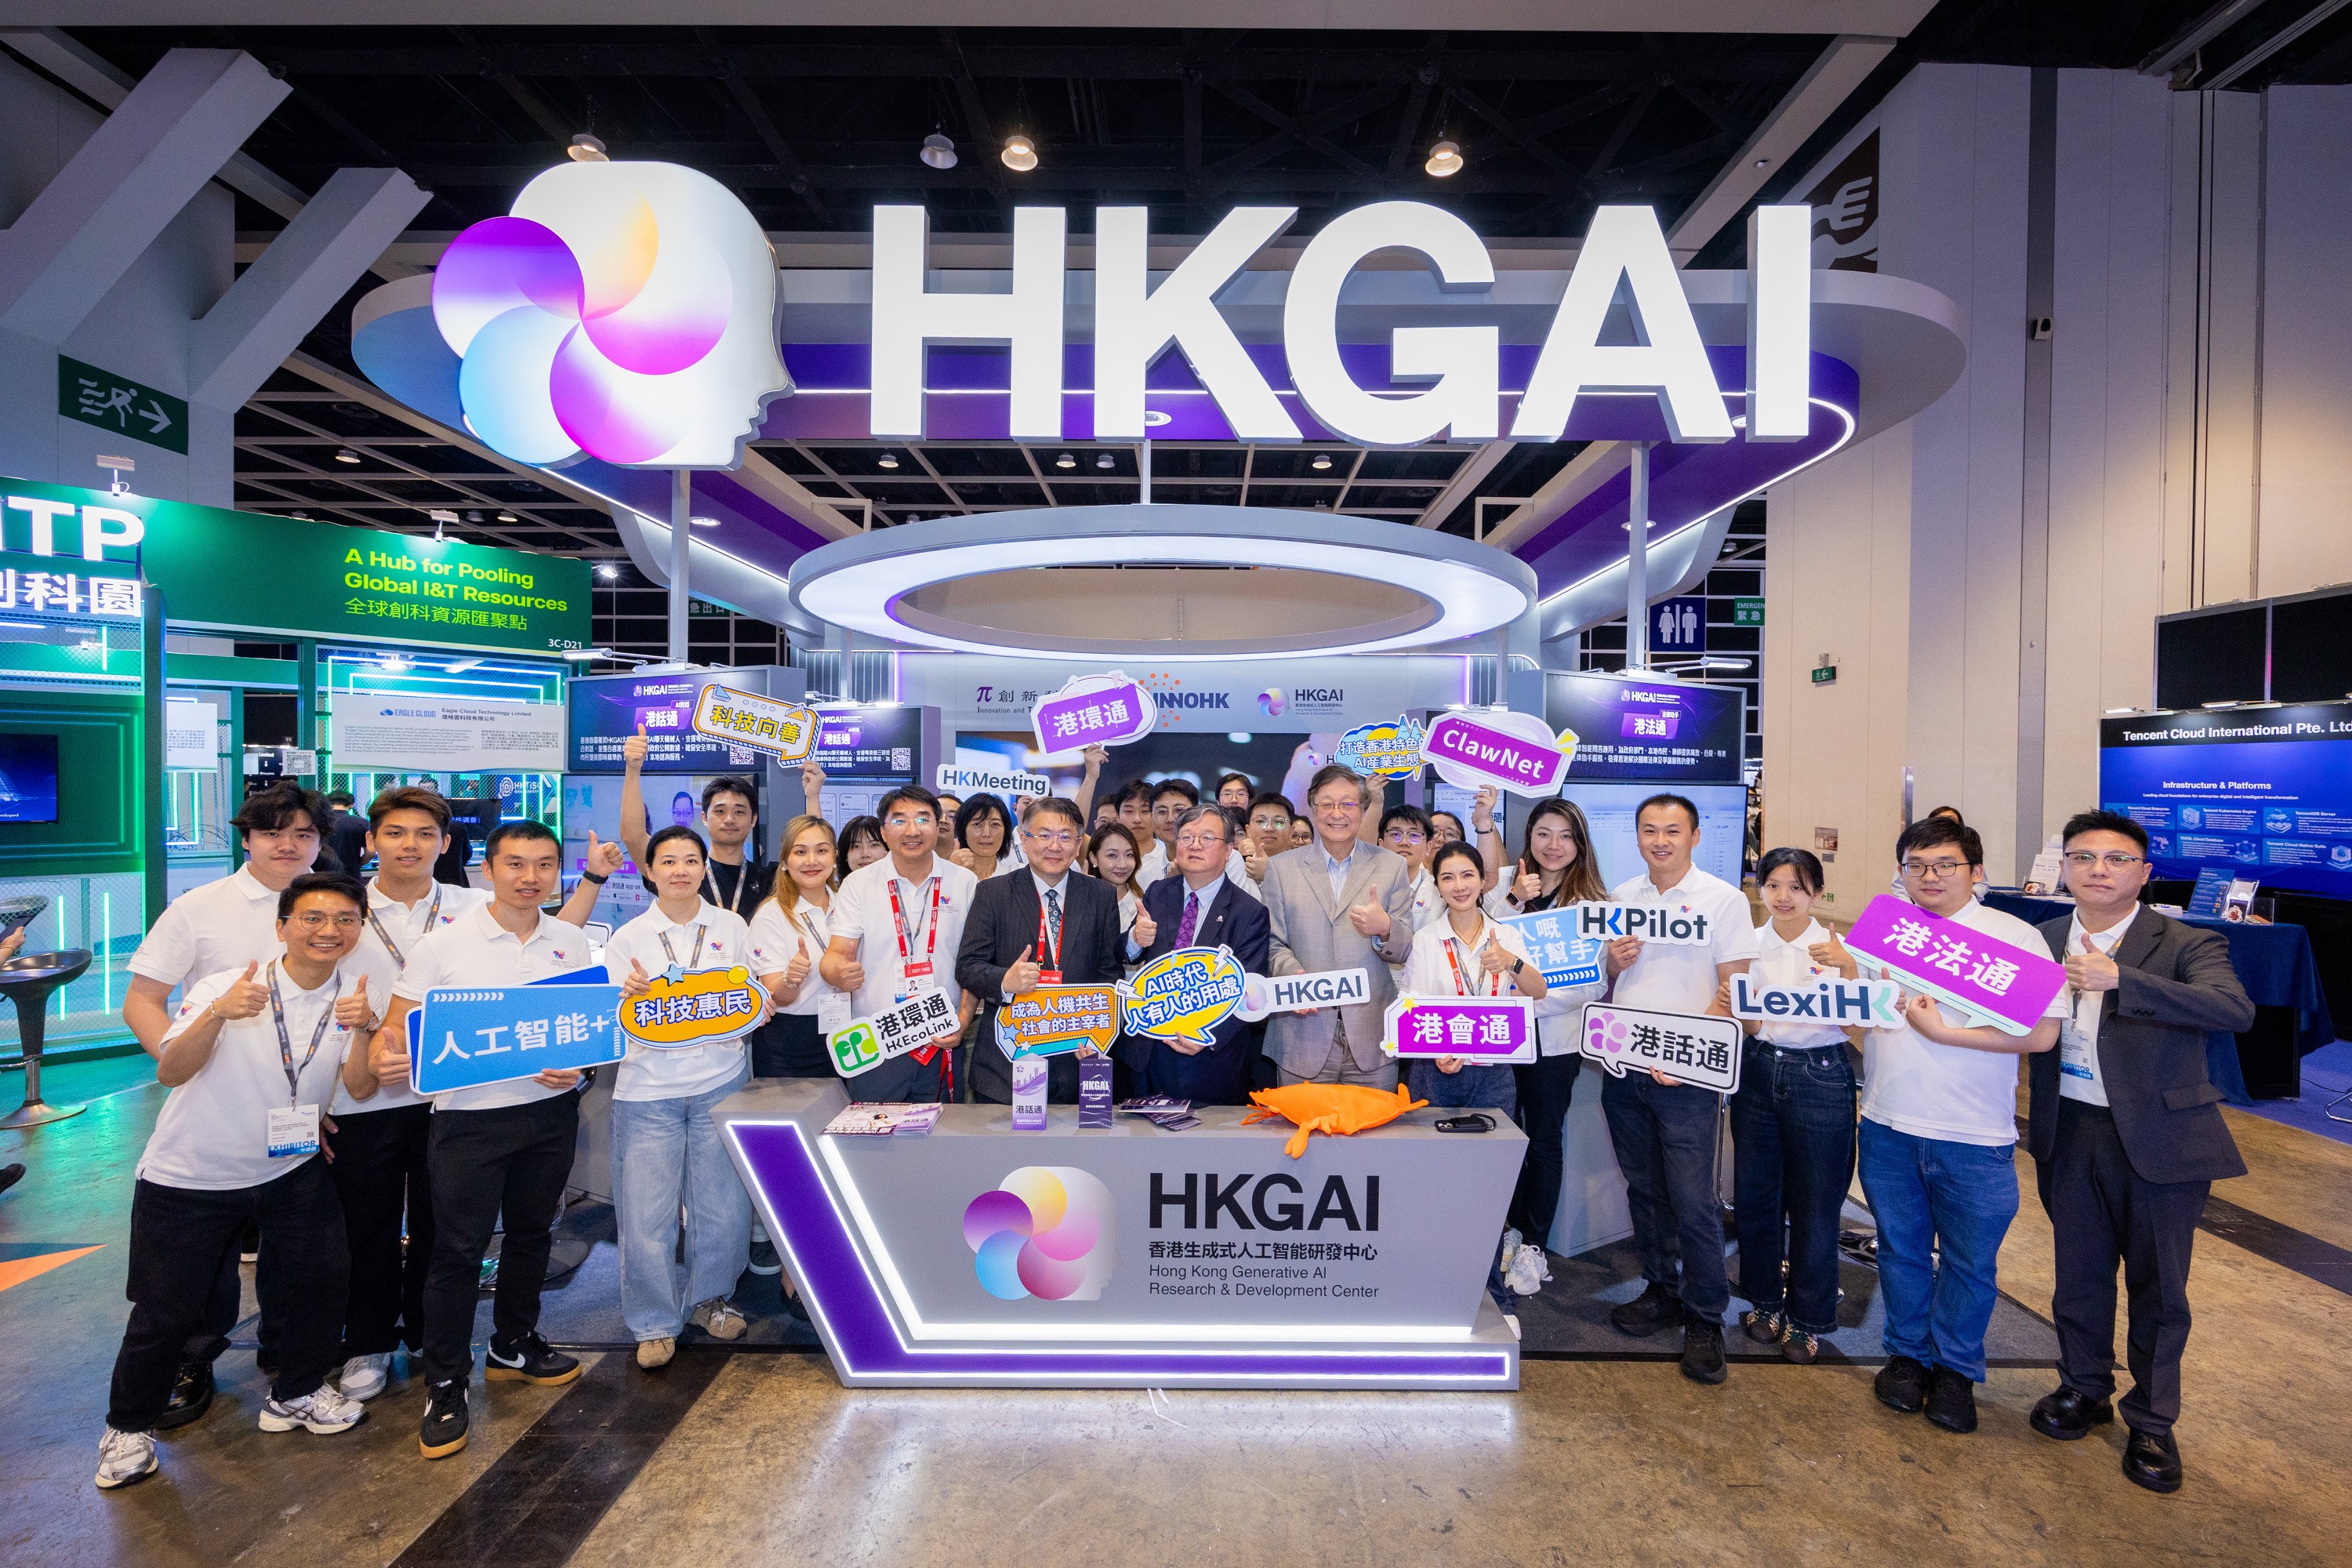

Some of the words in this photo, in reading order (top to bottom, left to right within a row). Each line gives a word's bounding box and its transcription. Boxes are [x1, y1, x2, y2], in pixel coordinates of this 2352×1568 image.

[870, 201, 1812, 446] HKGAI
[0, 495, 145, 562] TP
[344, 548, 364, 565] A
[369, 550, 416, 572] Hub
[421, 557, 454, 575] for
[459, 562, 534, 590] Pooling
[344, 572, 417, 594] Global
[423, 581, 458, 599] I&T
[463, 585, 568, 612] Resources
[345, 597, 528, 631] 全球創科資源匯聚點
[548, 638, 583, 650] 3C-D21
[643, 684, 667, 696] HKGAI
[1153, 692, 1230, 709] INNOHK
[1295, 688, 1344, 702] HKGAI
[1632, 691, 1656, 703] HKGAI
[645, 710, 678, 728] 港話通
[710, 704, 802, 745] 科技向善
[1053, 699, 1131, 738] 港環通
[1634, 717, 1667, 736] 港法通
[2123, 730, 2169, 742] Tencent
[2170, 728, 2206, 739] Cloud
[2209, 724, 2292, 738] International
[2296, 722, 2325, 735] Pte.
[1443, 729, 1545, 779] ClawNet
[942, 770, 1047, 796] HKMeeting
[2162, 781, 2218, 789] Infrastructure
[1583, 906, 1709, 941] HKPilot
[1882, 916, 2021, 996] 港法通
[1146, 963, 1207, 996] AI時代
[1274, 975, 1364, 1006] HKGAI
[634, 988, 753, 1027] 科技惠民
[875, 993, 950, 1040] 港環通
[1011, 993, 1110, 1019] 成為人機共生
[1130, 976, 1241, 1032] 人有人的用處
[1737, 979, 1896, 1022] LexiHK
[885, 1018, 954, 1054] HKEcoLink
[1022, 1013, 1111, 1037] 社會的主宰者
[1412, 1013, 1512, 1046] 港會通
[1630, 1023, 1730, 1075] 港話通
[1082, 1080, 1110, 1091] HKGAI
[1015, 1105, 1043, 1114] 港話通
[268, 1140, 316, 1151] EXHIBITOR
[1149, 1172, 1381, 1232] HKGAI
[1149, 1241, 1378, 1261] 香港生成式人工智能研發中心
[1149, 1265, 1187, 1282] Hong
[1191, 1265, 1228, 1282] Kong
[1232, 1265, 1308, 1279] Generative
[1312, 1267, 1327, 1279] AI
[1149, 1282, 1217, 1296] Research
[1221, 1283, 1231, 1296] &
[1236, 1283, 1328, 1299] Development
[1331, 1284, 1379, 1298] Center
